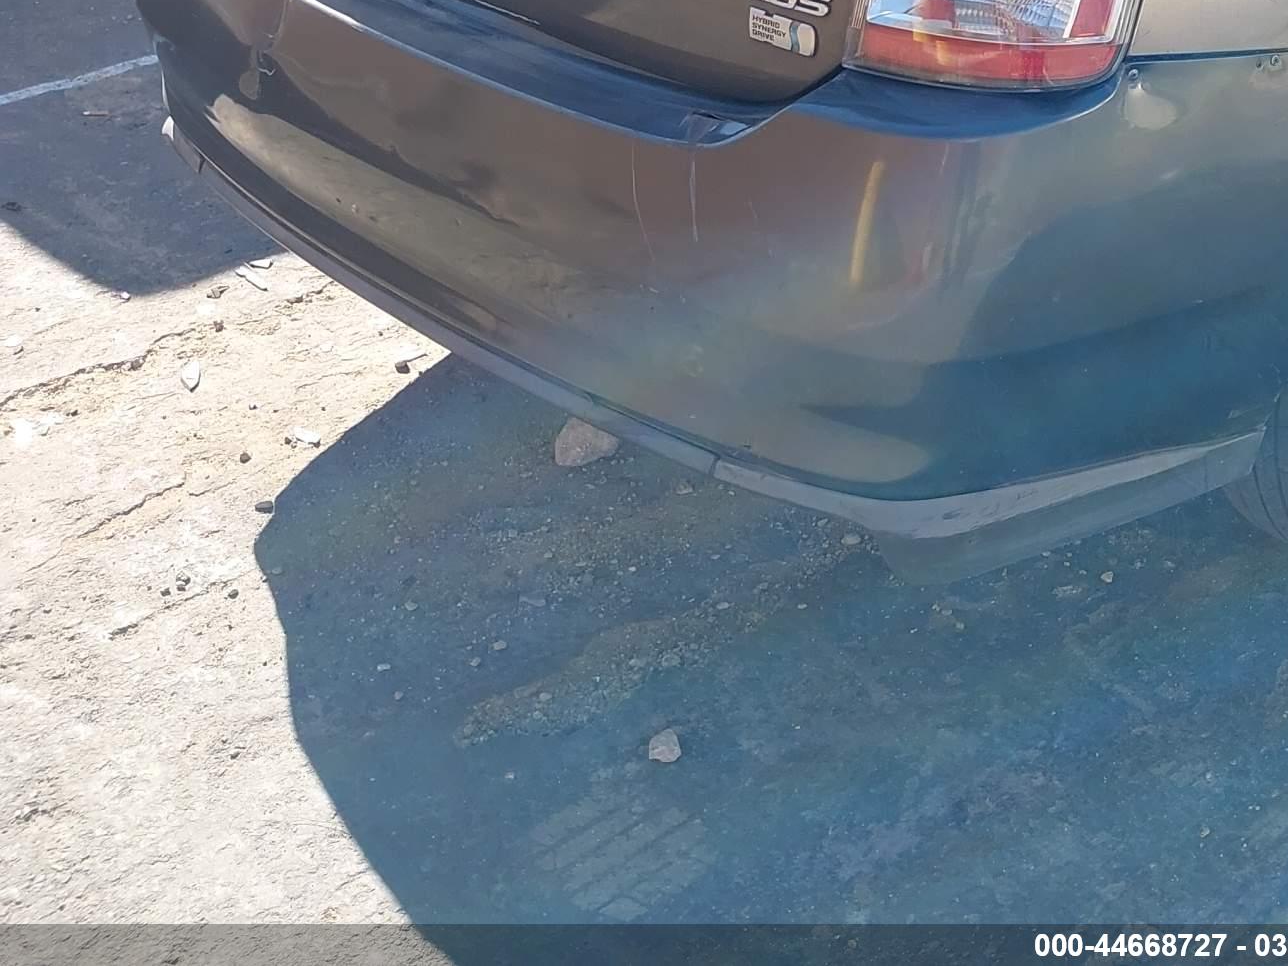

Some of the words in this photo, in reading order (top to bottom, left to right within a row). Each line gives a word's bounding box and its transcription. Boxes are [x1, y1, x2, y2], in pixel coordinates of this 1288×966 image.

[751, 15, 781, 29] HYBRID
[751, 22, 787, 38] SYNERGY
[751, 28, 775, 41] DRIVE
